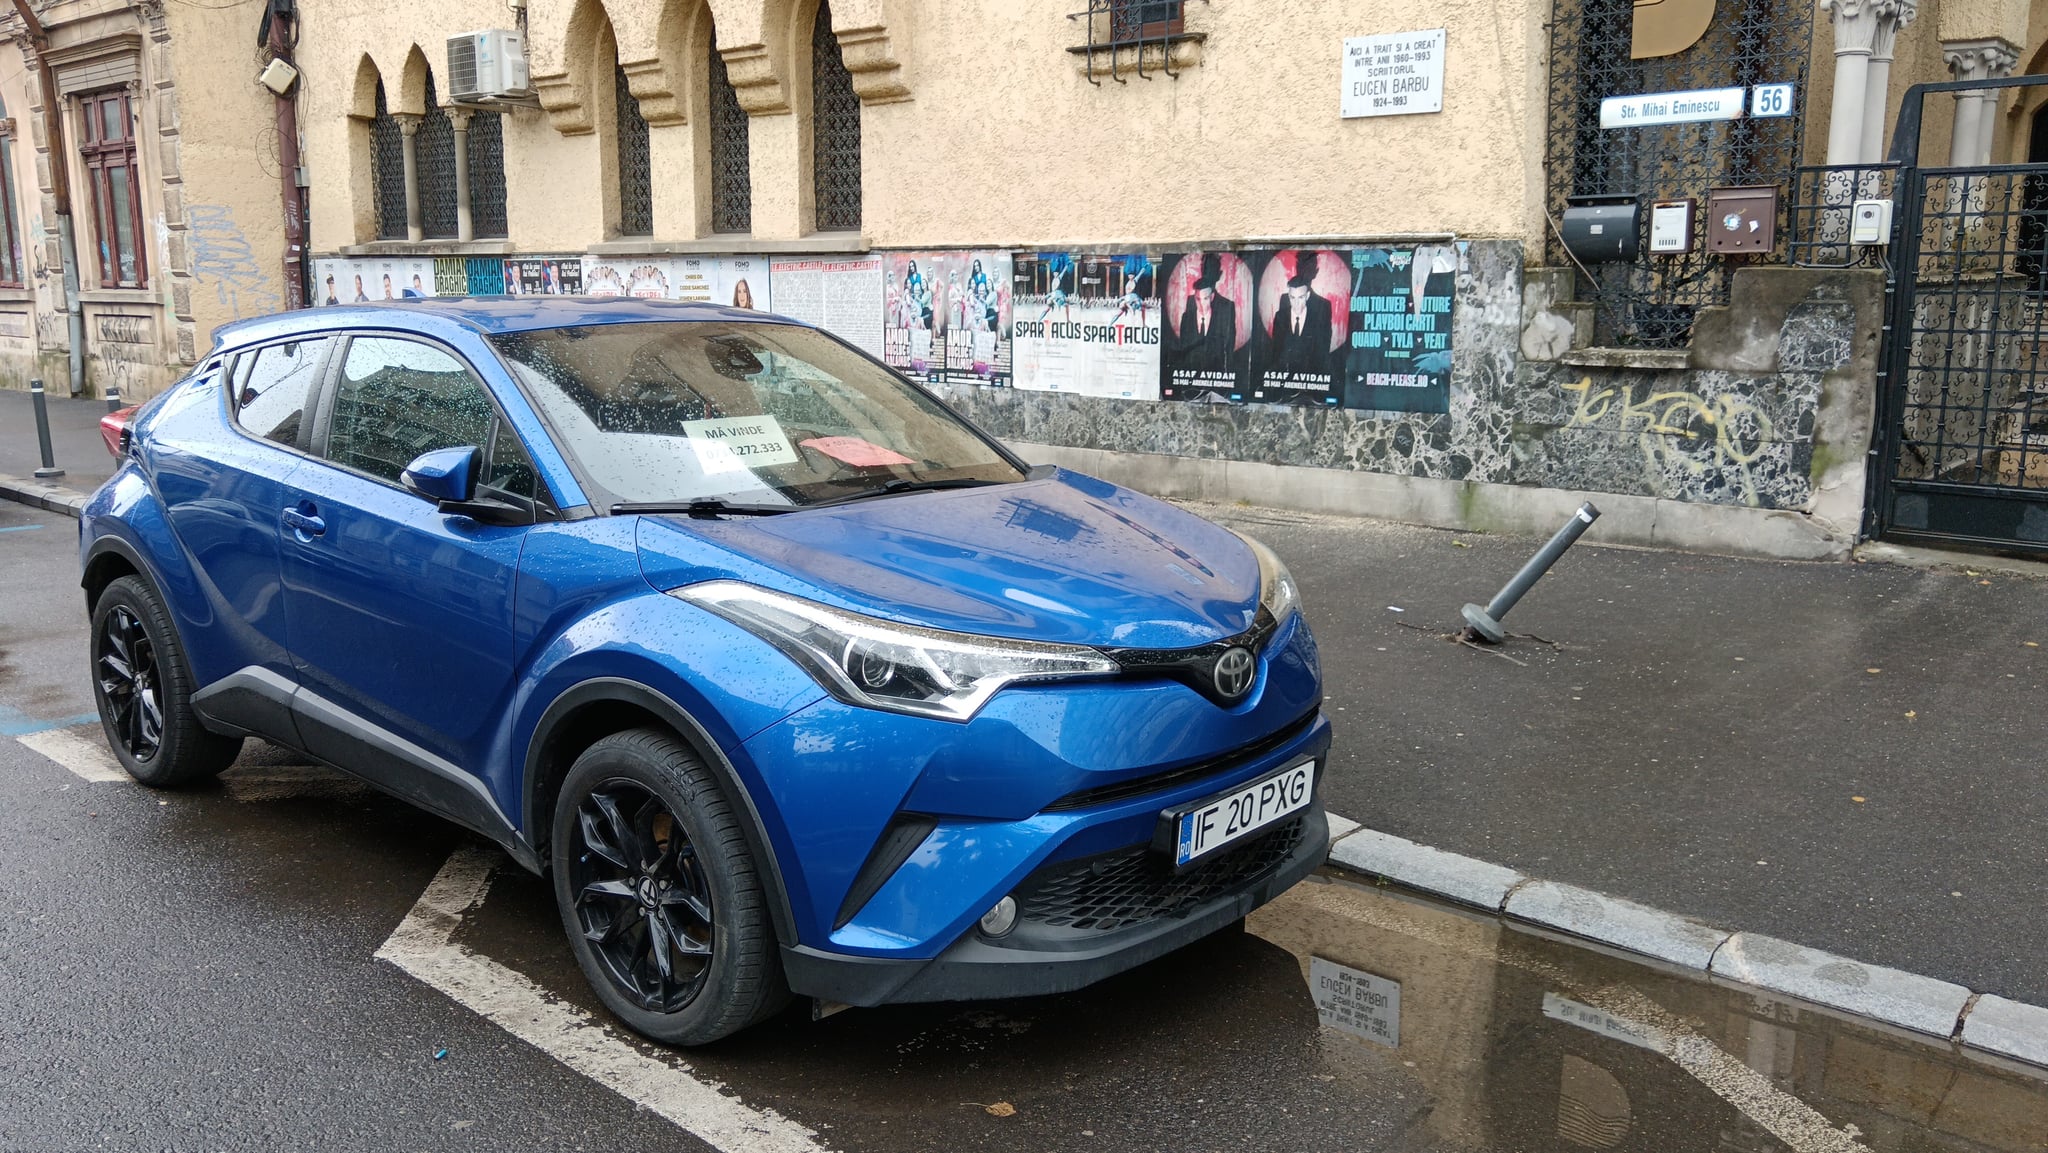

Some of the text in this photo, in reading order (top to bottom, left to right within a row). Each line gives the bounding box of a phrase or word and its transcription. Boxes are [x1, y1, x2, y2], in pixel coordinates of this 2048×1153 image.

[1349, 47, 1362, 56] AICI
[1374, 43, 1392, 54] TRAIT
[1414, 40, 1436, 50] CREAT
[1377, 55, 1390, 65] ANII
[1394, 51, 1431, 64] 1960-1993
[1368, 64, 1415, 78] SCRIITORUL
[1354, 76, 1429, 97] EUGEN BARBU
[1373, 96, 1408, 108] 1924-1993
[1760, 88, 1783, 113] 56
[1620, 99, 1720, 120] Str. Mihai Eminescu
[434, 258, 467, 276] DAMIAN
[468, 259, 504, 276] DAMIAN
[434, 276, 468, 292] DRAGHIC
[1350, 296, 1451, 312] DON TOLIVER UTURE
[1015, 320, 1082, 340] SPARTACUS
[1364, 314, 1435, 332] PLAYBOI CARTI
[1083, 324, 1159, 346] SPARTACUS
[1352, 332, 1447, 349] QUAVO TYLA YEAT
[1172, 370, 1236, 380] ASAF AVIDAN
[1264, 371, 1331, 382] ASAF AVIDAN
[1366, 373, 1428, 388] BEACH-PLEASE.RO
[727, 425, 765, 438] VINDE
[1194, 770, 1306, 851] IF 20 PXG
[1180, 840, 1191, 858] RO
